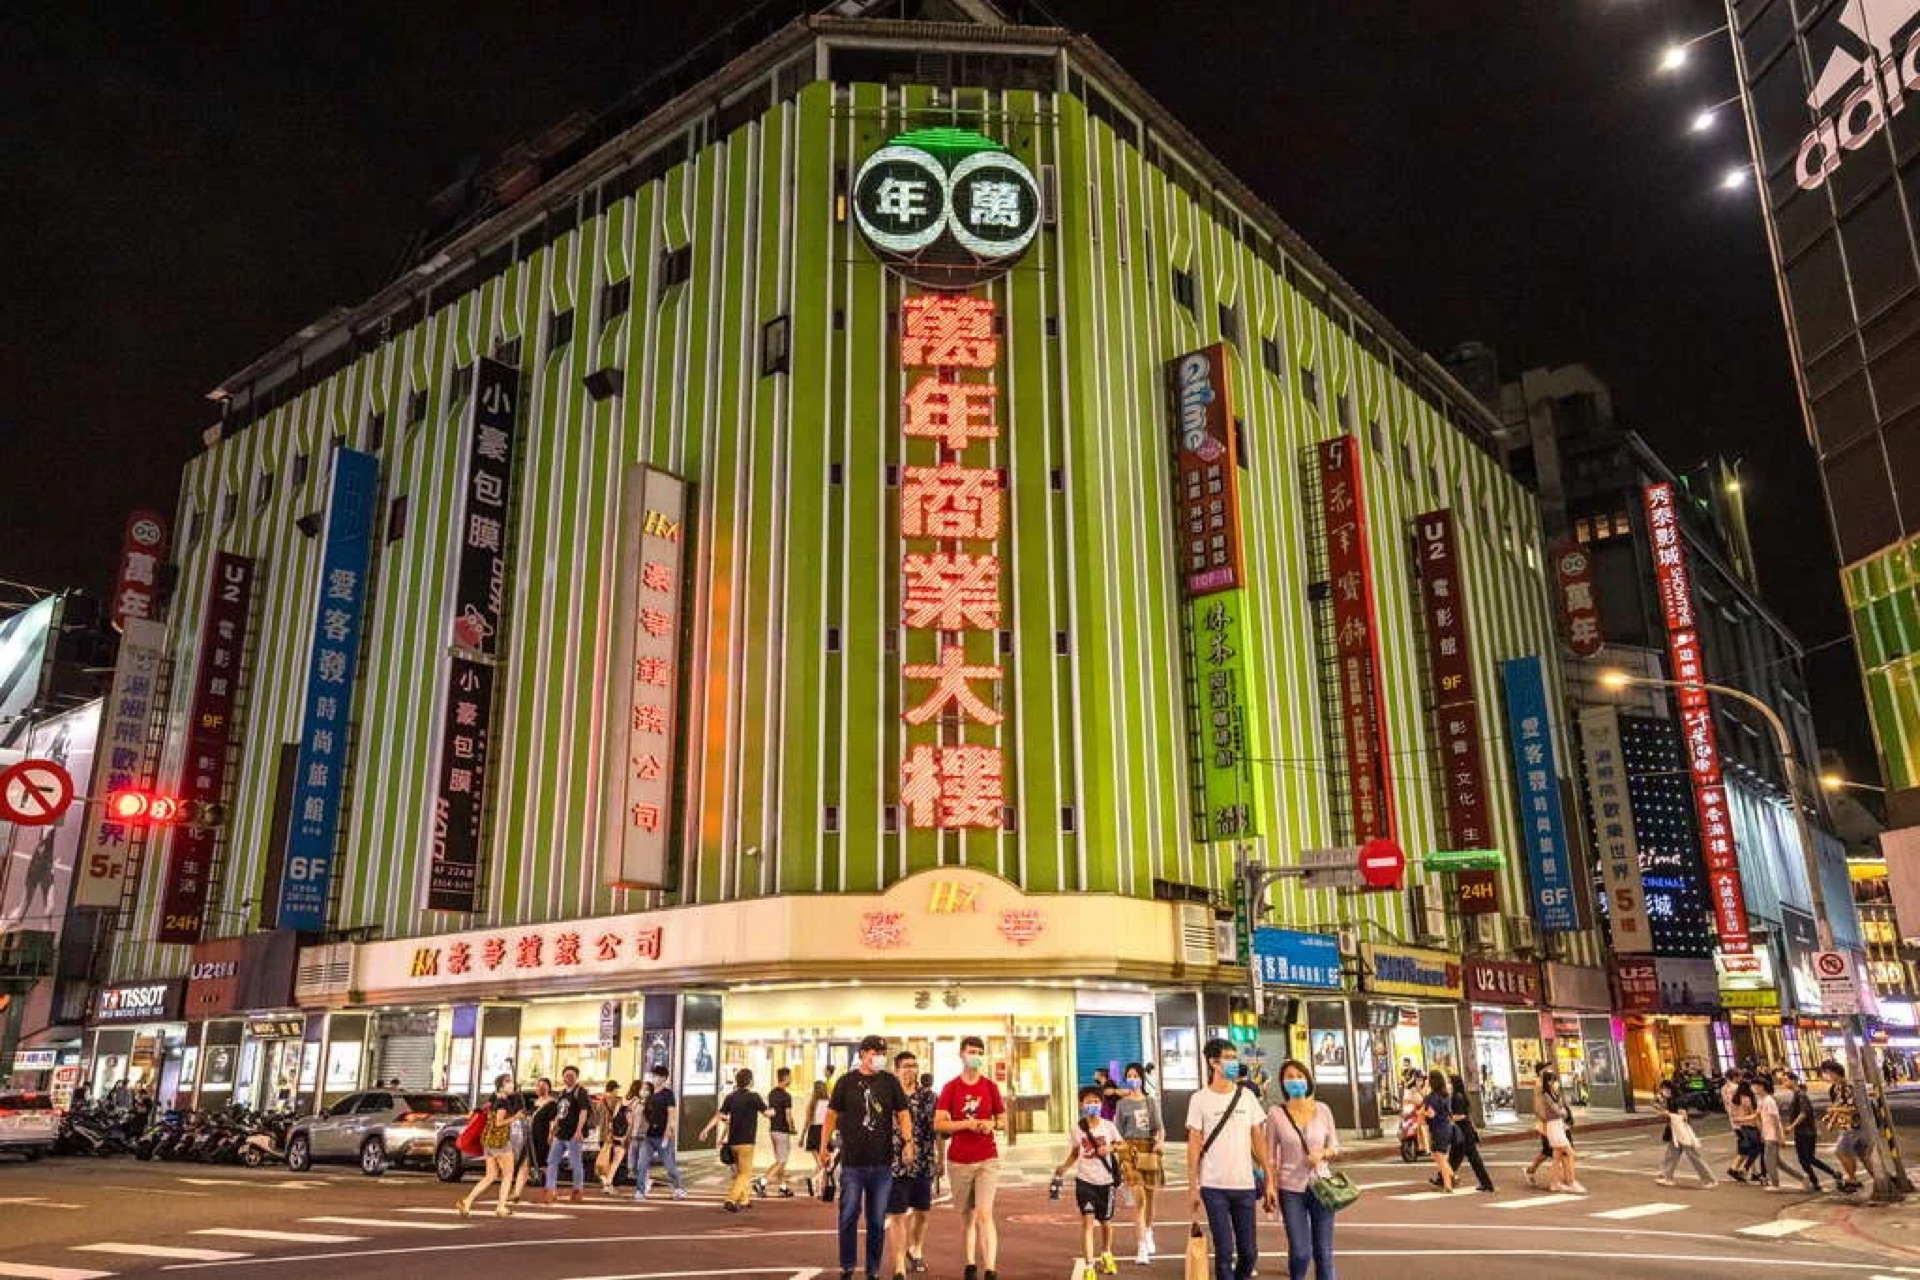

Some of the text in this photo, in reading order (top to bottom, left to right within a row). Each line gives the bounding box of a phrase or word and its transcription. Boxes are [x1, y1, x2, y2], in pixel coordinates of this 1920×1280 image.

[900, 295, 1005, 829] 萬年商業大樓
[96, 674, 152, 848] 湯姆熊歡樂界
[88, 854, 124, 880] 5F
[289, 856, 327, 882] 6F
[1460, 882, 1495, 901] 24H
[1540, 887, 1569, 907] 6F
[164, 914, 201, 932] 24H
[120, 986, 167, 1006] TISSOT
